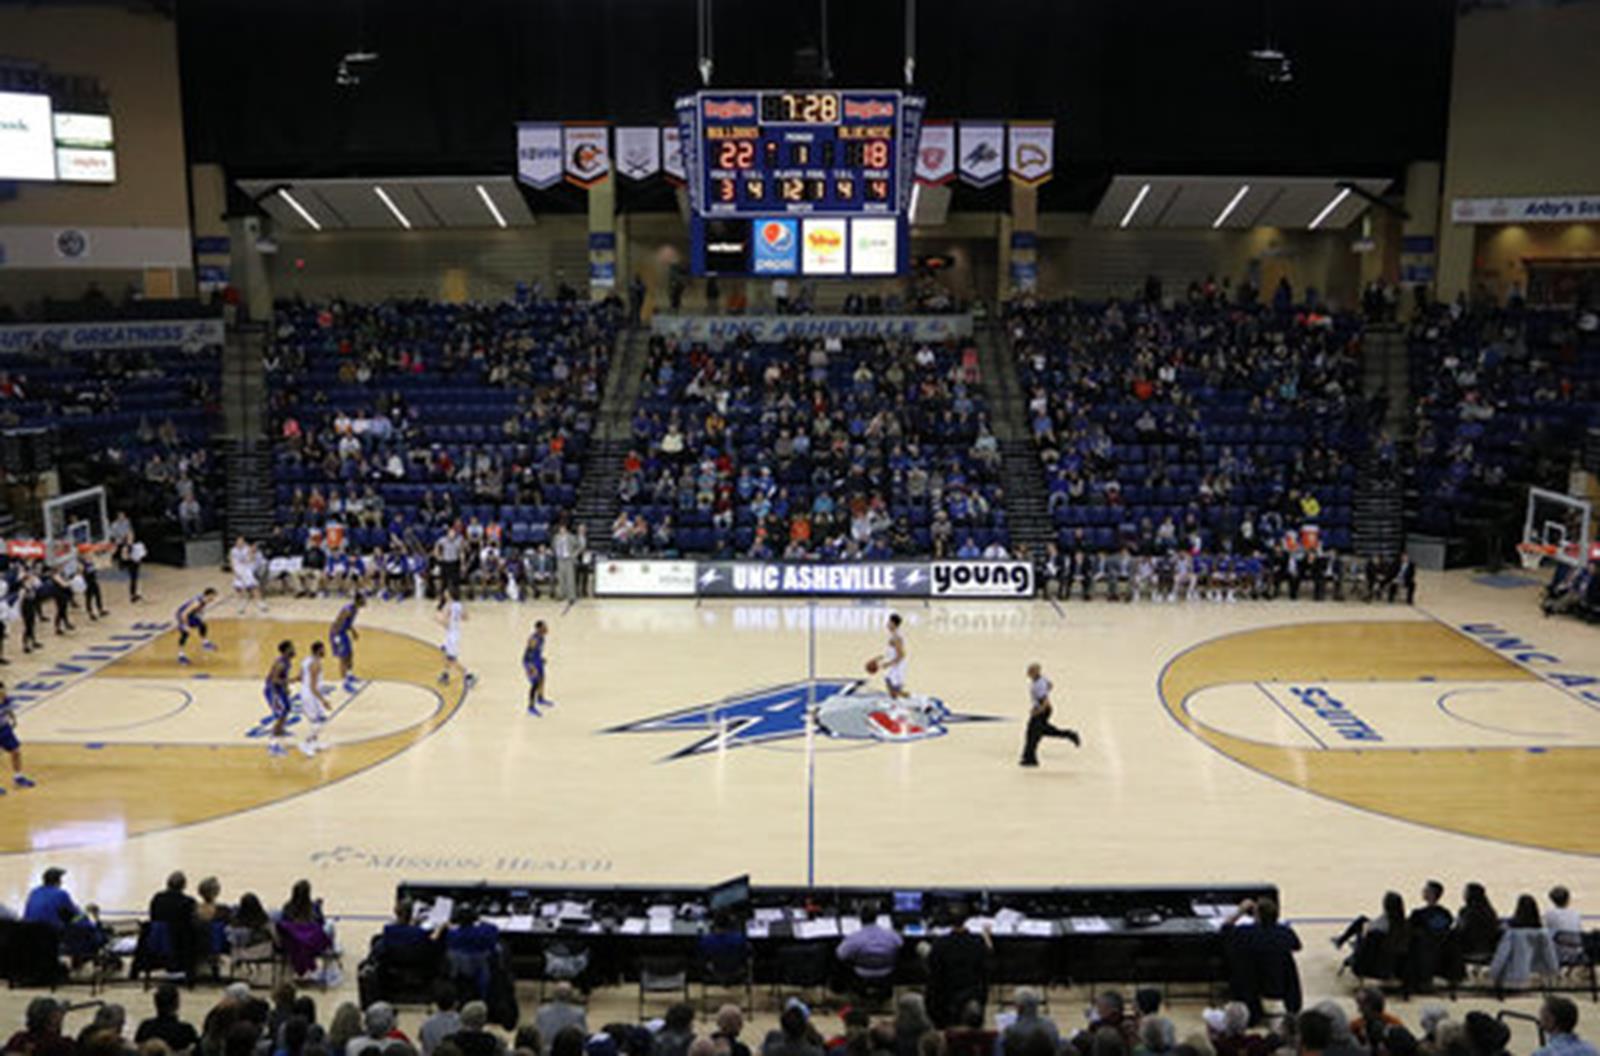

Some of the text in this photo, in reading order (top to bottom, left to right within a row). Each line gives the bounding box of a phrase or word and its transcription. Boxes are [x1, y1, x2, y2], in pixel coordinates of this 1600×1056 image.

[782, 94, 837, 122] 7:28
[720, 142, 753, 168] 22
[863, 142, 887, 168] 18
[721, 180, 734, 200] 3
[747, 181, 763, 199] 4
[837, 181, 852, 199] 4
[872, 181, 887, 199] 4
[708, 319, 918, 336] UNC ASHEVILLE
[732, 564, 897, 591] UNC ASHEVILLE
[934, 565, 1029, 592] young
